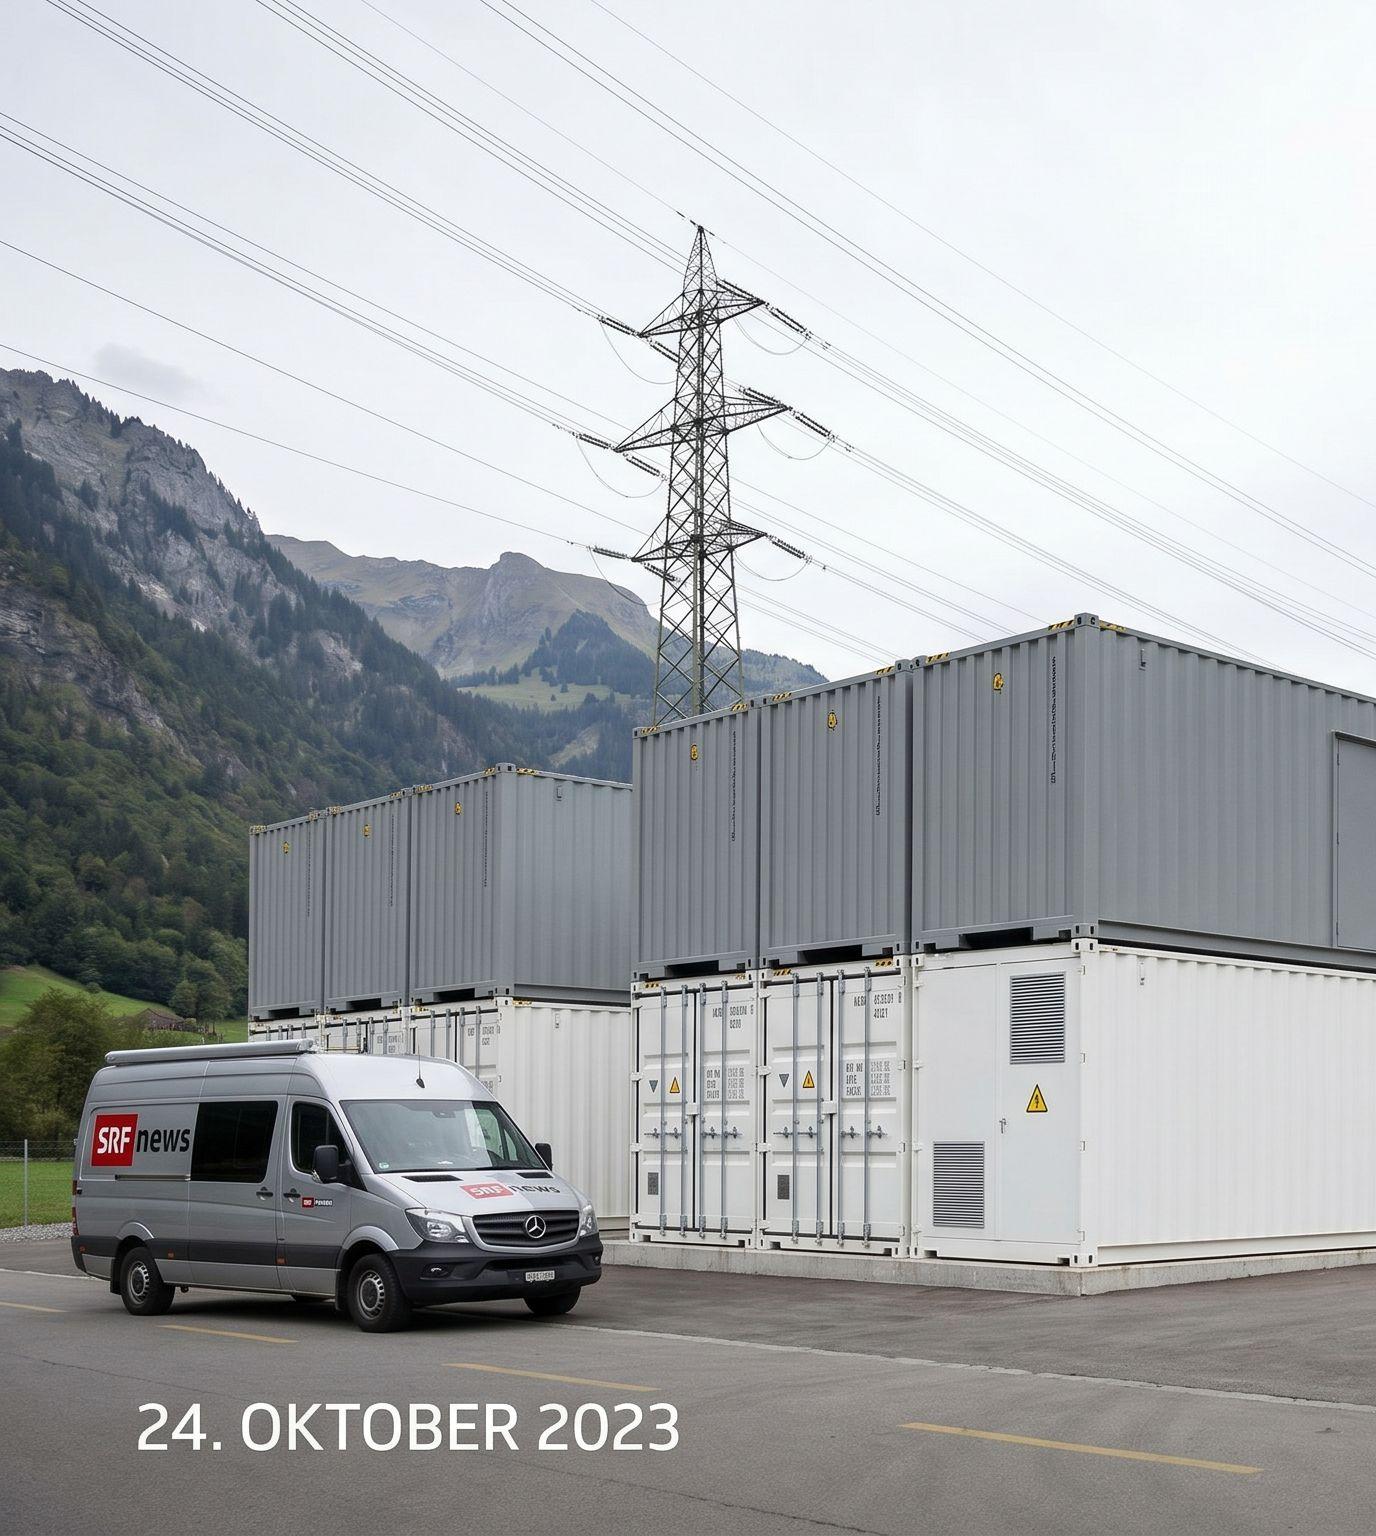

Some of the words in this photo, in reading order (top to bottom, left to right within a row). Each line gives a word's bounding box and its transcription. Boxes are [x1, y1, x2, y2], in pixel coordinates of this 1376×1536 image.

[97, 1126, 132, 1154] SRF
[136, 1128, 191, 1153] news
[508, 1185, 561, 1194] news
